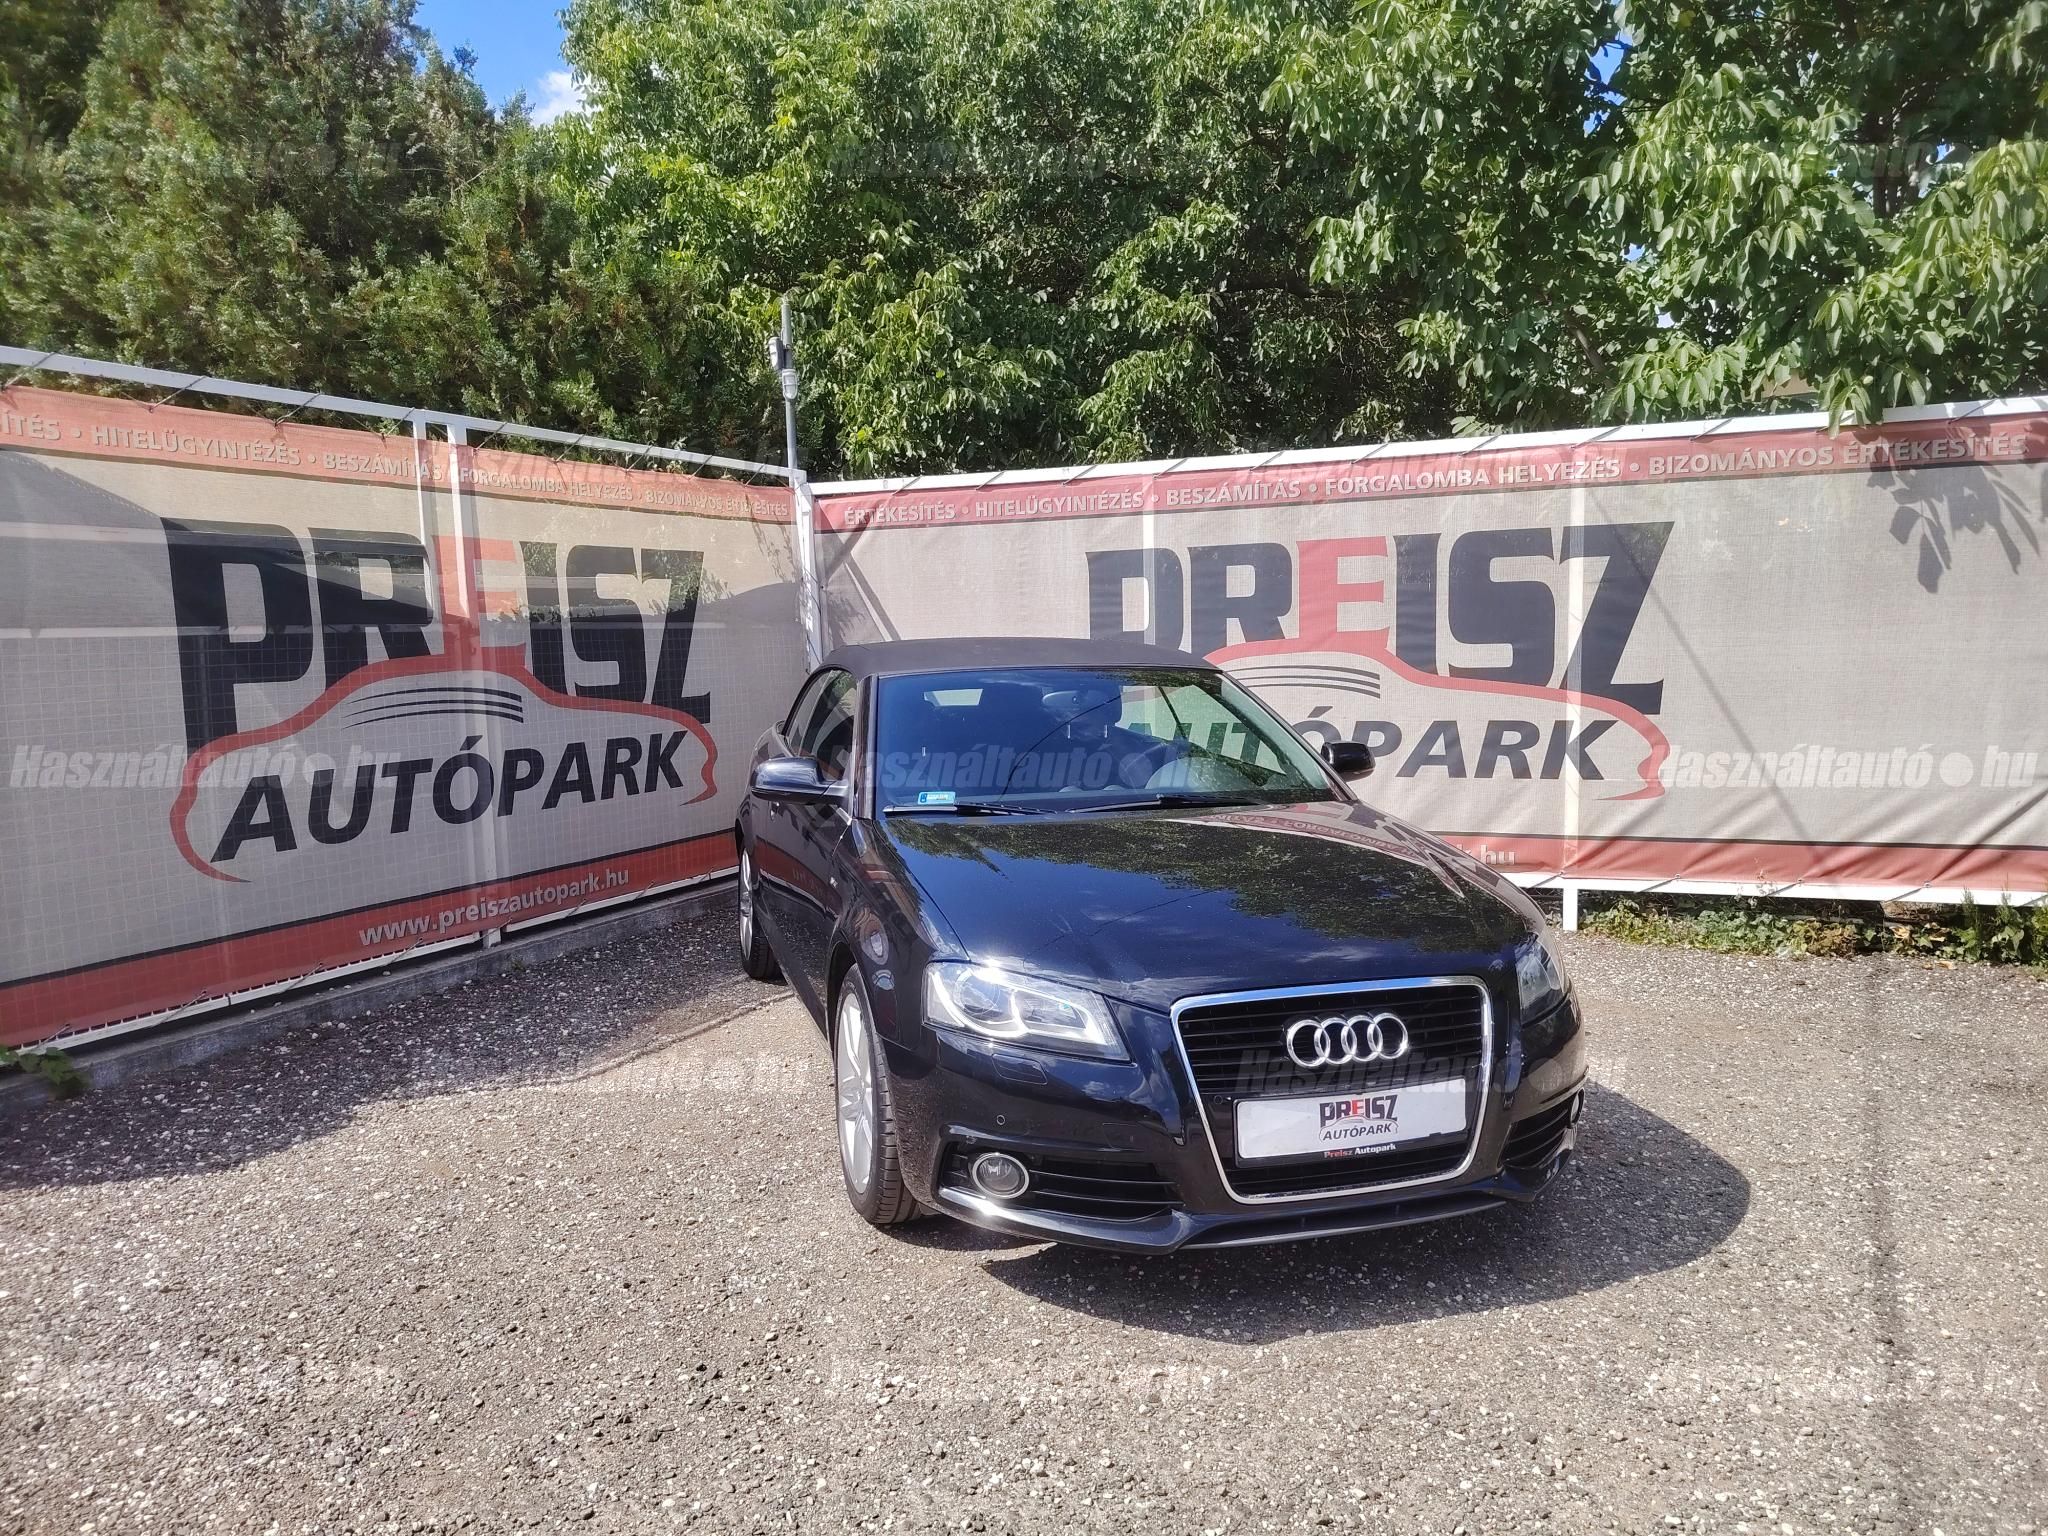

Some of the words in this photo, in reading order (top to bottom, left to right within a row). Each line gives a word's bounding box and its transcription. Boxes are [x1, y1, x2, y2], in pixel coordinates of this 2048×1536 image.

[0, 409, 61, 441] ÍTÉS
[92, 424, 301, 466] HITELÜGYINTÉZÉS
[323, 453, 441, 481] BESZÁMÍTÁS
[461, 467, 567, 495] FORGALOMBA
[570, 481, 633, 501] HELYEZÉS
[844, 501, 955, 526] ÉRTÉKESÍTÉS
[975, 488, 1143, 518] HITELÜGYINTÉZÉS
[1166, 479, 1301, 506] BESZÁMÍTÁS
[1325, 468, 1490, 496] FORGALOMBA
[1499, 456, 1620, 484] HELYEZÉS
[1649, 445, 1834, 476] BIZOMÁNYOS
[1843, 433, 2029, 466] ÉRTÉKESÍTÉS
[160, 516, 711, 760] PREISZ
[1086, 521, 1675, 715] PREISZ
[211, 730, 688, 864] AUTÓPARK
[359, 868, 630, 946] www.preiszautopark.hu
[1320, 1094, 1398, 1128] PREISZ
[1322, 1122, 1392, 1141] AUTÓPARK
[1354, 1143, 1396, 1156] Autopark
